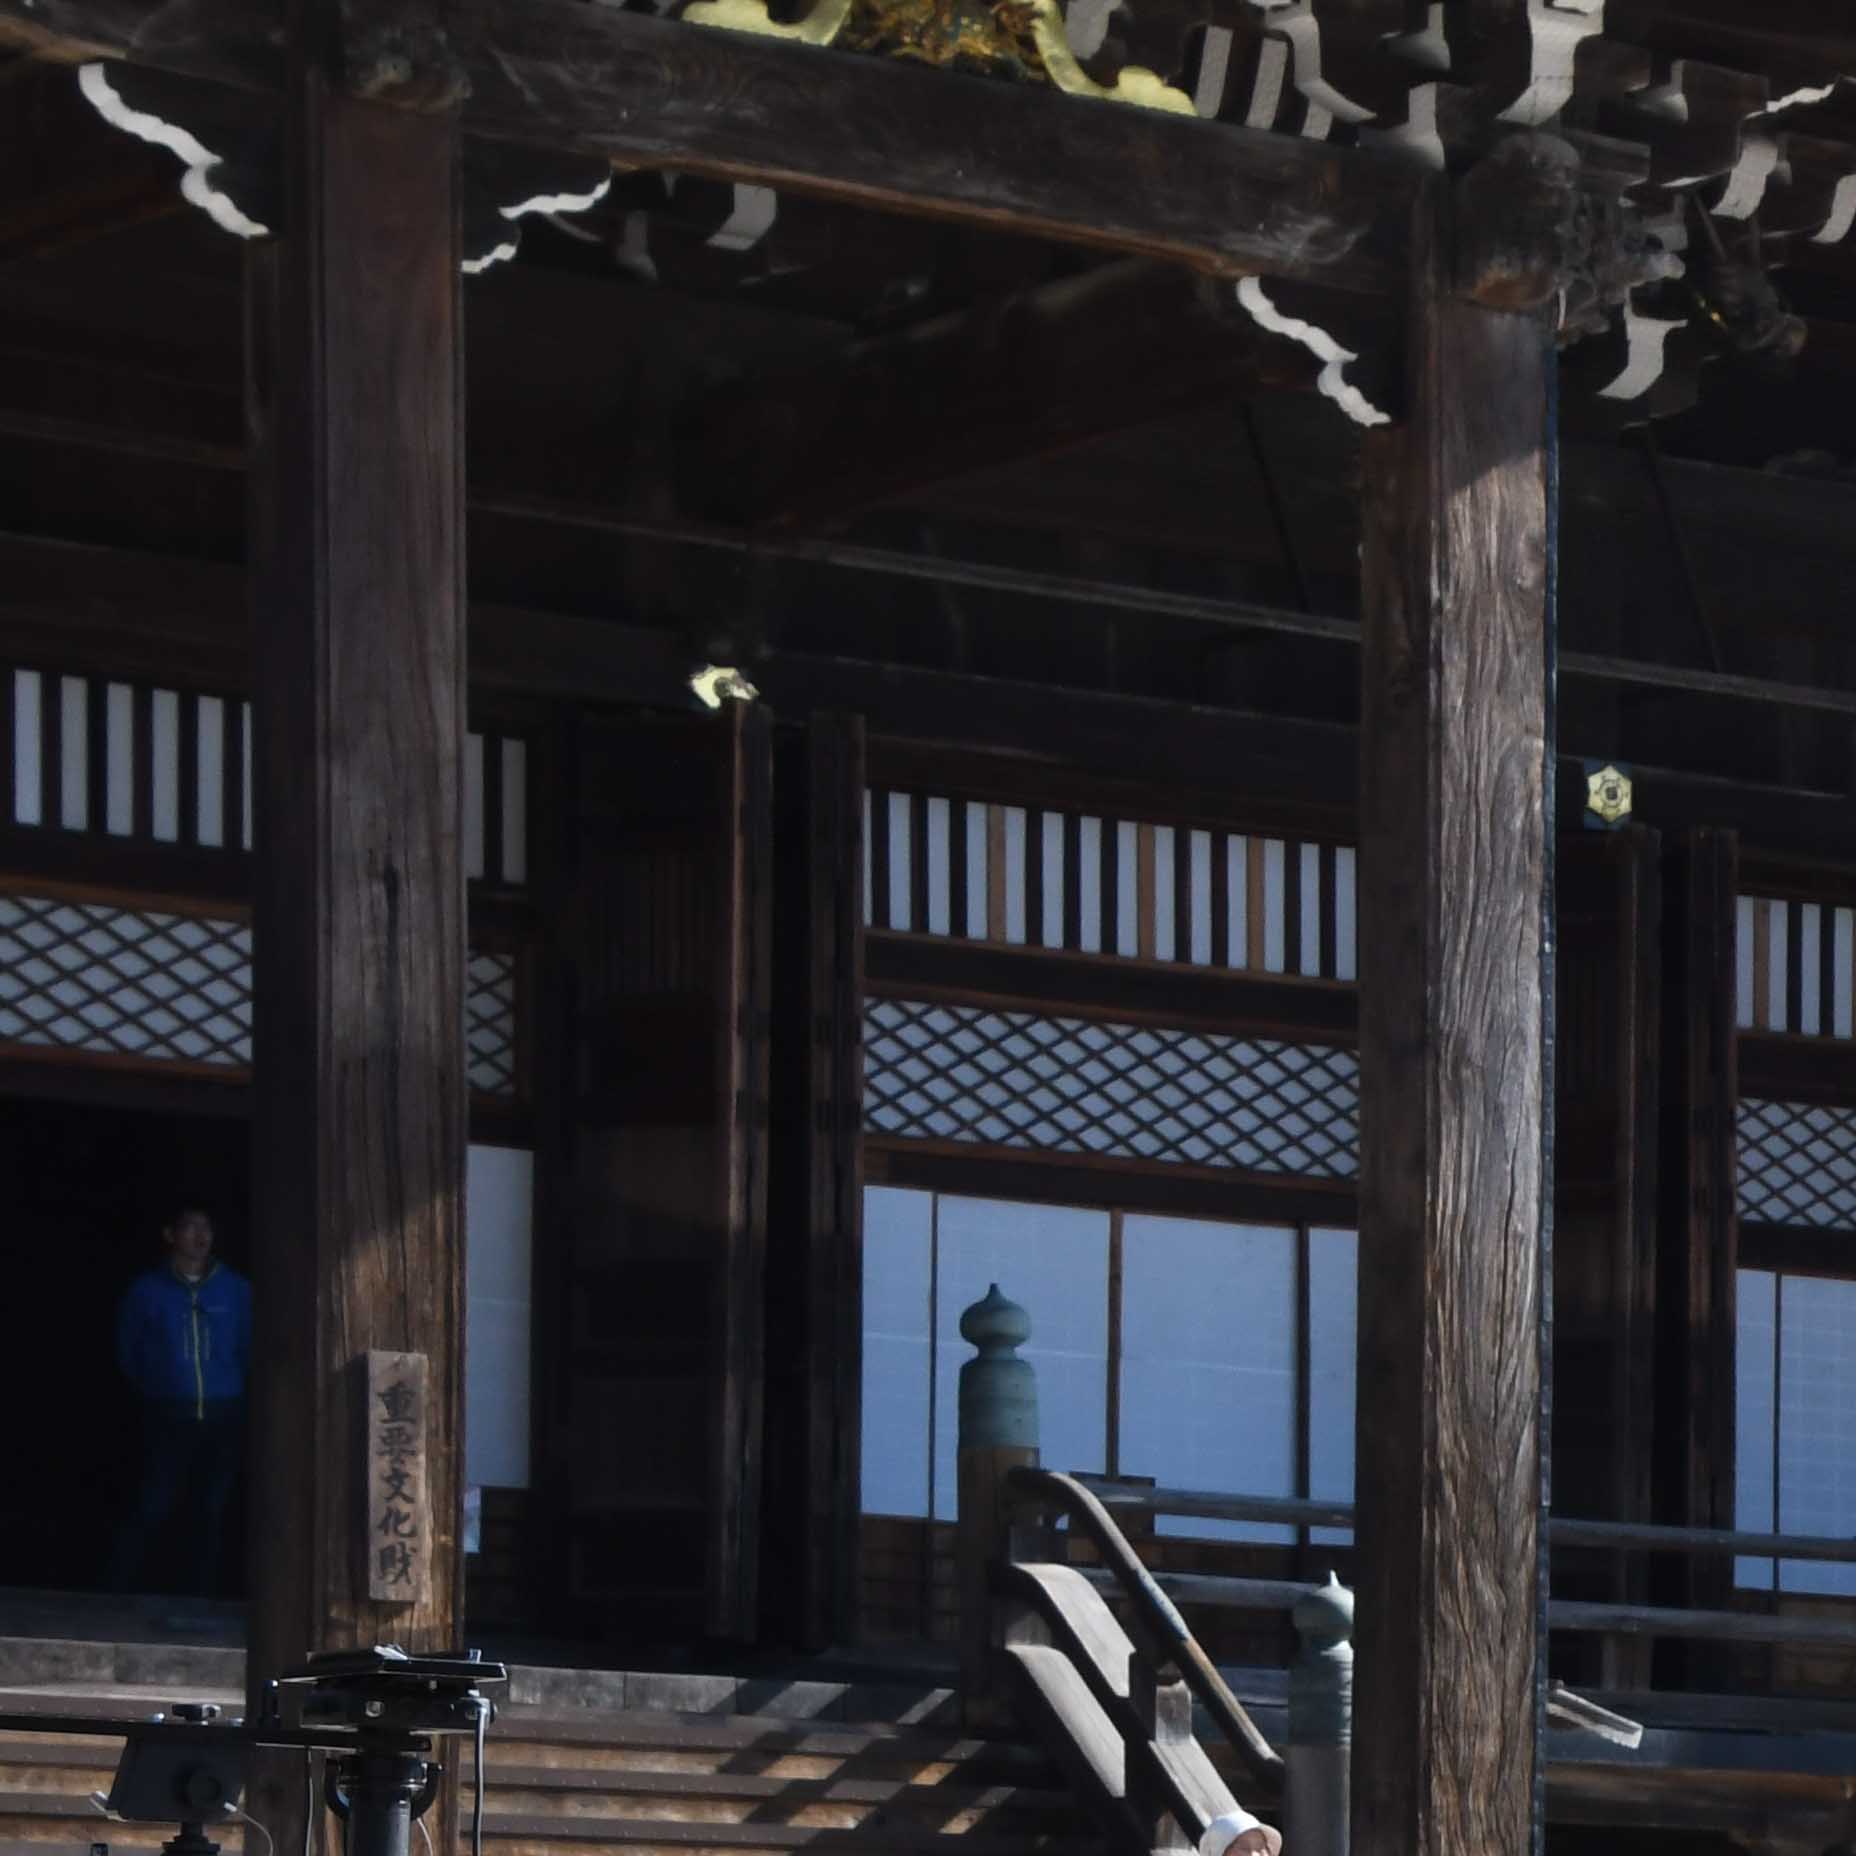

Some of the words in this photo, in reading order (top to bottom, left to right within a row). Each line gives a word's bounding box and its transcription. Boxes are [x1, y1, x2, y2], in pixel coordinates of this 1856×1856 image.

[376, 1381, 418, 1585] 重要文化財
